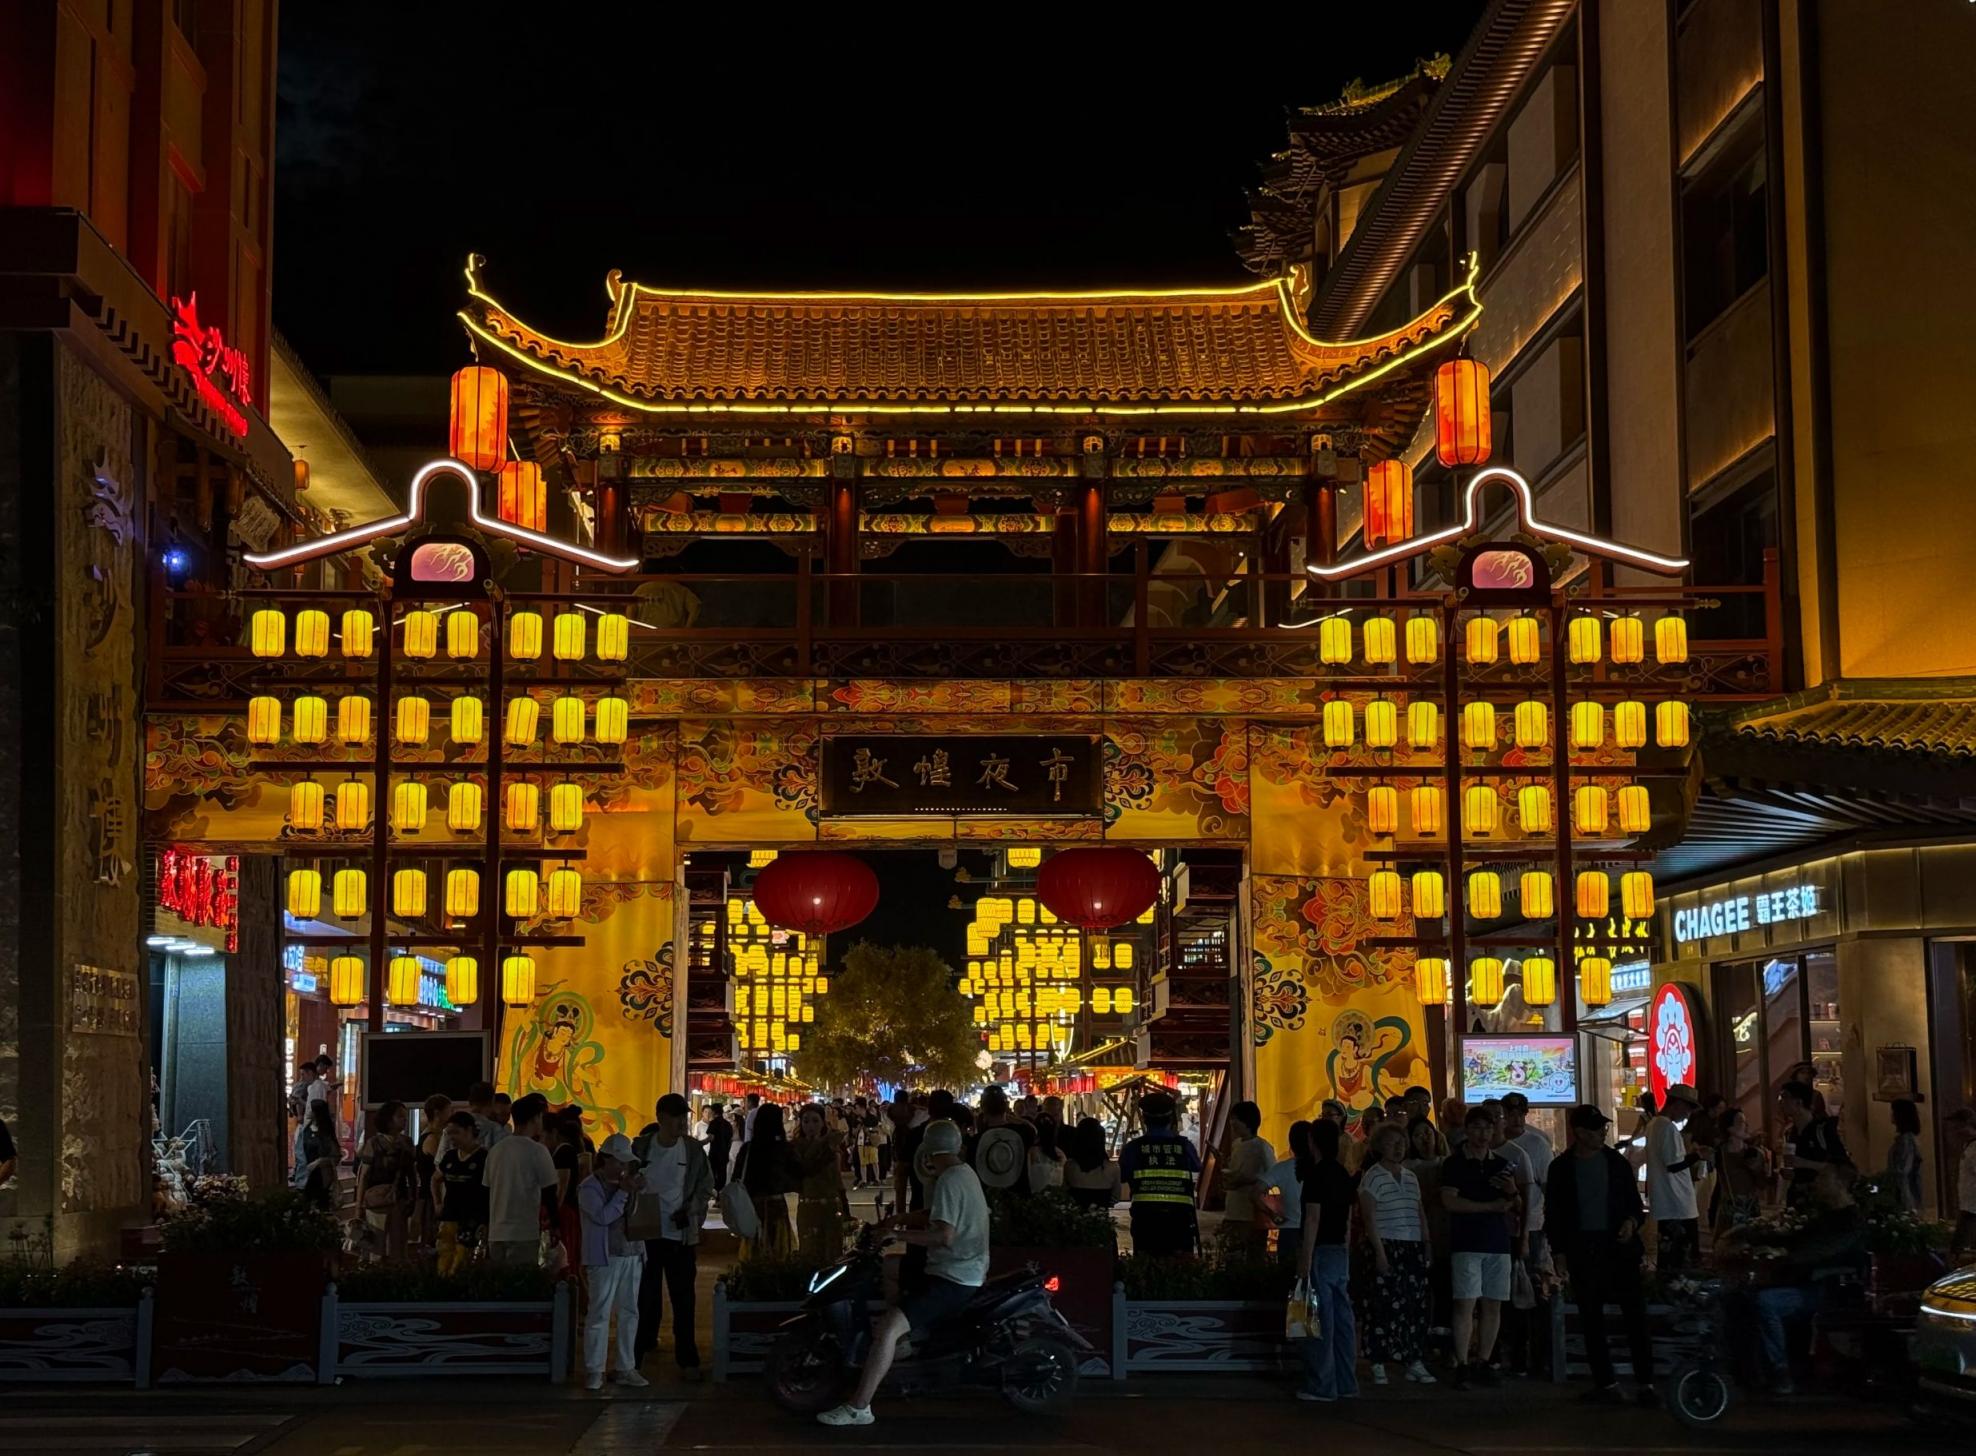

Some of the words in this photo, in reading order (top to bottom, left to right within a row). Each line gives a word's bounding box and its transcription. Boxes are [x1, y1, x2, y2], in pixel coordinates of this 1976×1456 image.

[849, 747, 1075, 802] 敦煌夜市
[1674, 897, 1750, 942] CHAGEE
[1756, 885, 1818, 924] 霸王茶姬
